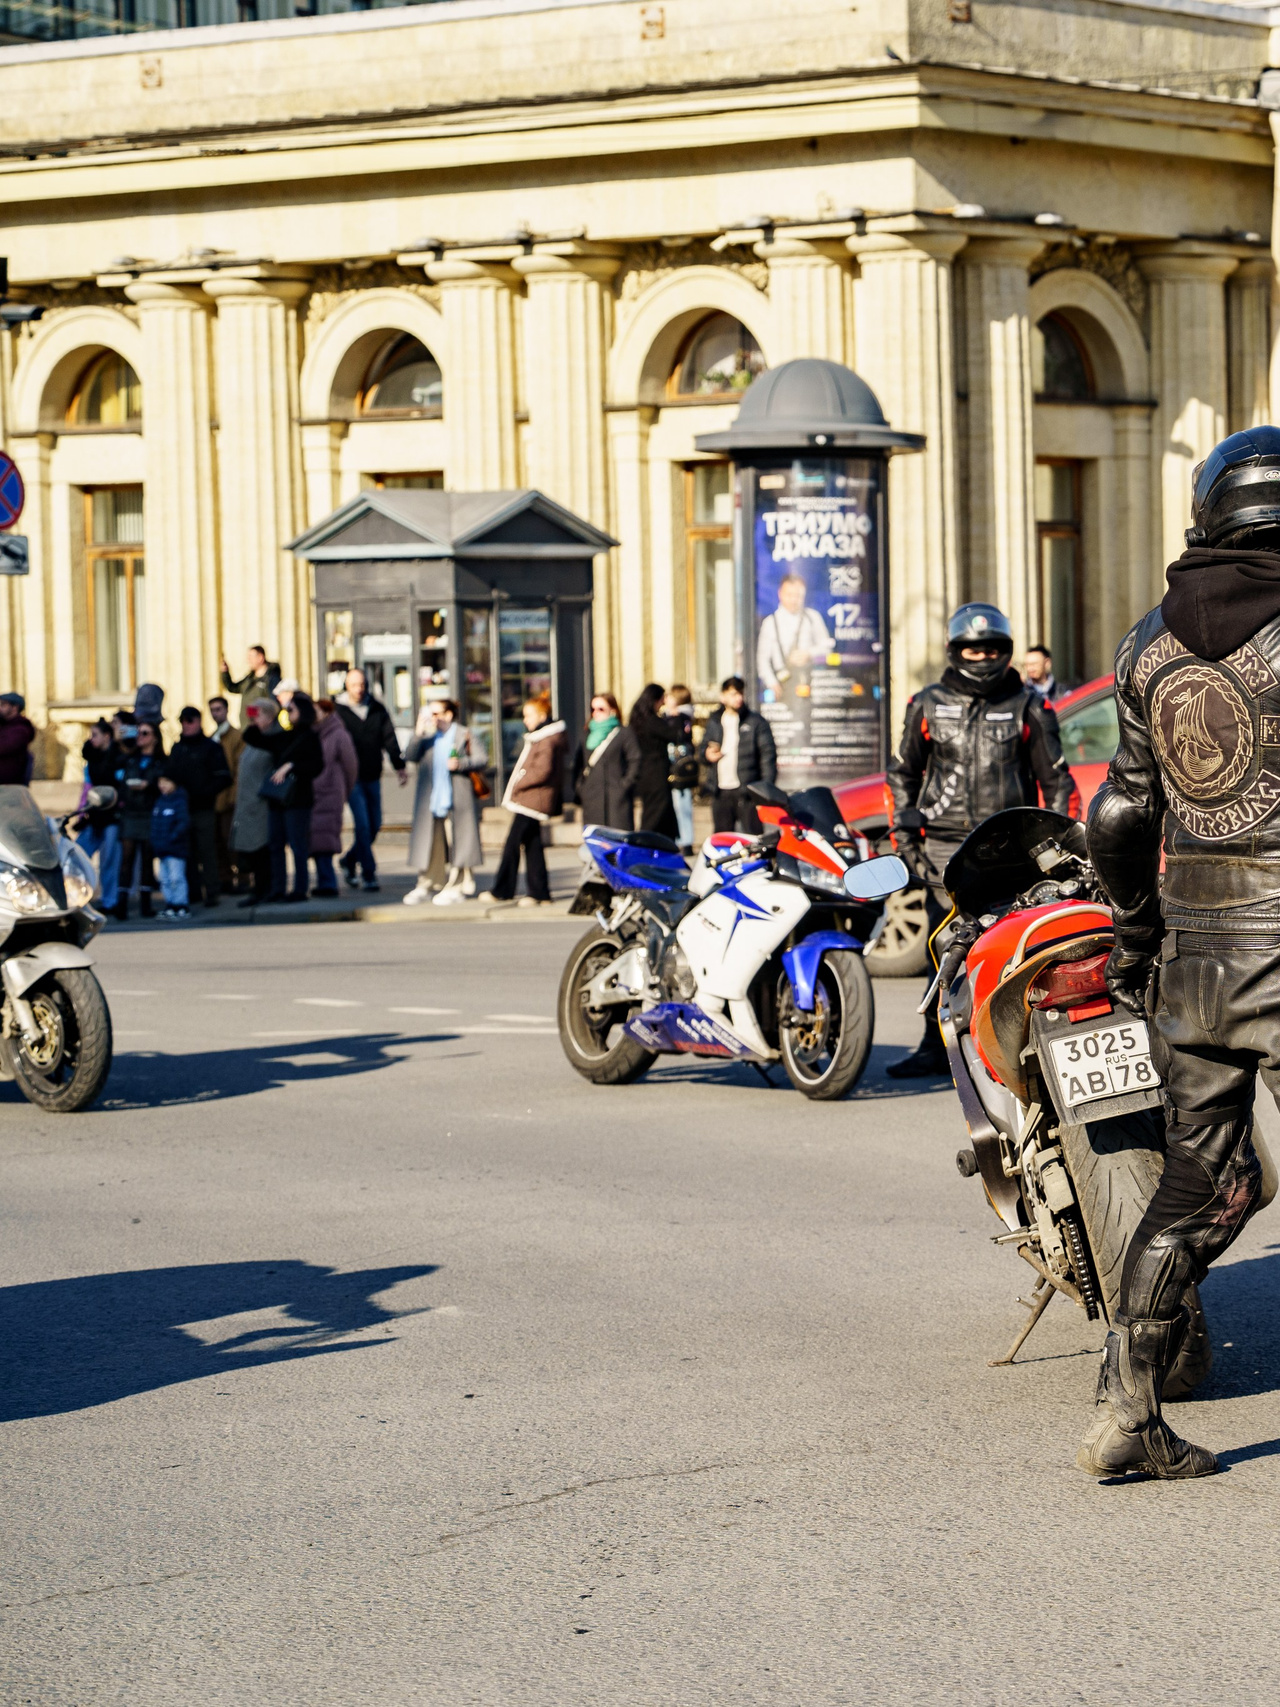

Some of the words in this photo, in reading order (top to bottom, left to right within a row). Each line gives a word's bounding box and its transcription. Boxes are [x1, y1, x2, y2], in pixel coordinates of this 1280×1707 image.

[772, 534, 866, 562] ДЖАЗА
[827, 603, 861, 627] 17
[1064, 1028, 1136, 1062] 3025
[1105, 1054, 1128, 1066] RUS
[1115, 1061, 1152, 1088] 78
